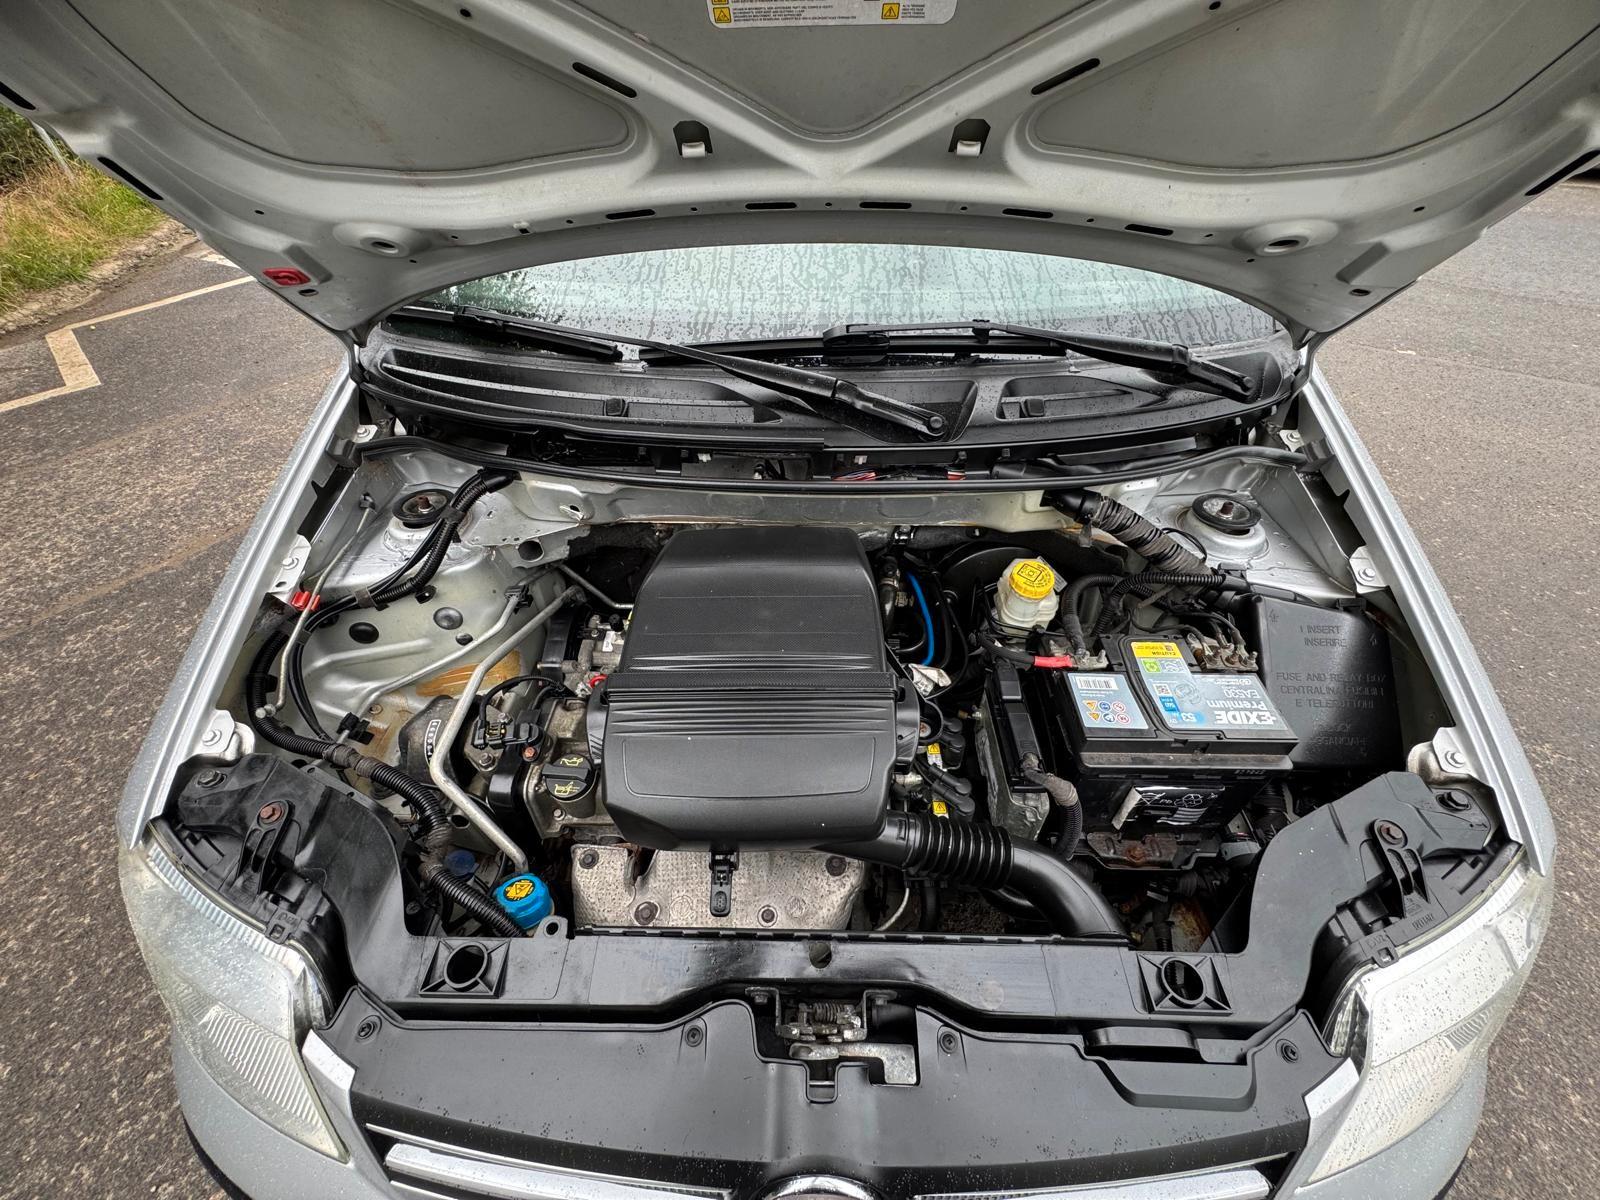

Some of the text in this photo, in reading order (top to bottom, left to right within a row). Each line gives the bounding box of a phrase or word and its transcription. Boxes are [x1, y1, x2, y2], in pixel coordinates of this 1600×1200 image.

[1306, 624, 1341, 634] INSERT
[1304, 638, 1347, 648] INSERIRE
[1276, 672, 1302, 681] FUSE
[1306, 672, 1326, 681] AND
[1329, 672, 1362, 682] RELAY
[1224, 689, 1260, 699] EA530
[1206, 699, 1268, 711] Premium
[1180, 712, 1198, 722] 53
[1213, 710, 1277, 725] EXIDE
